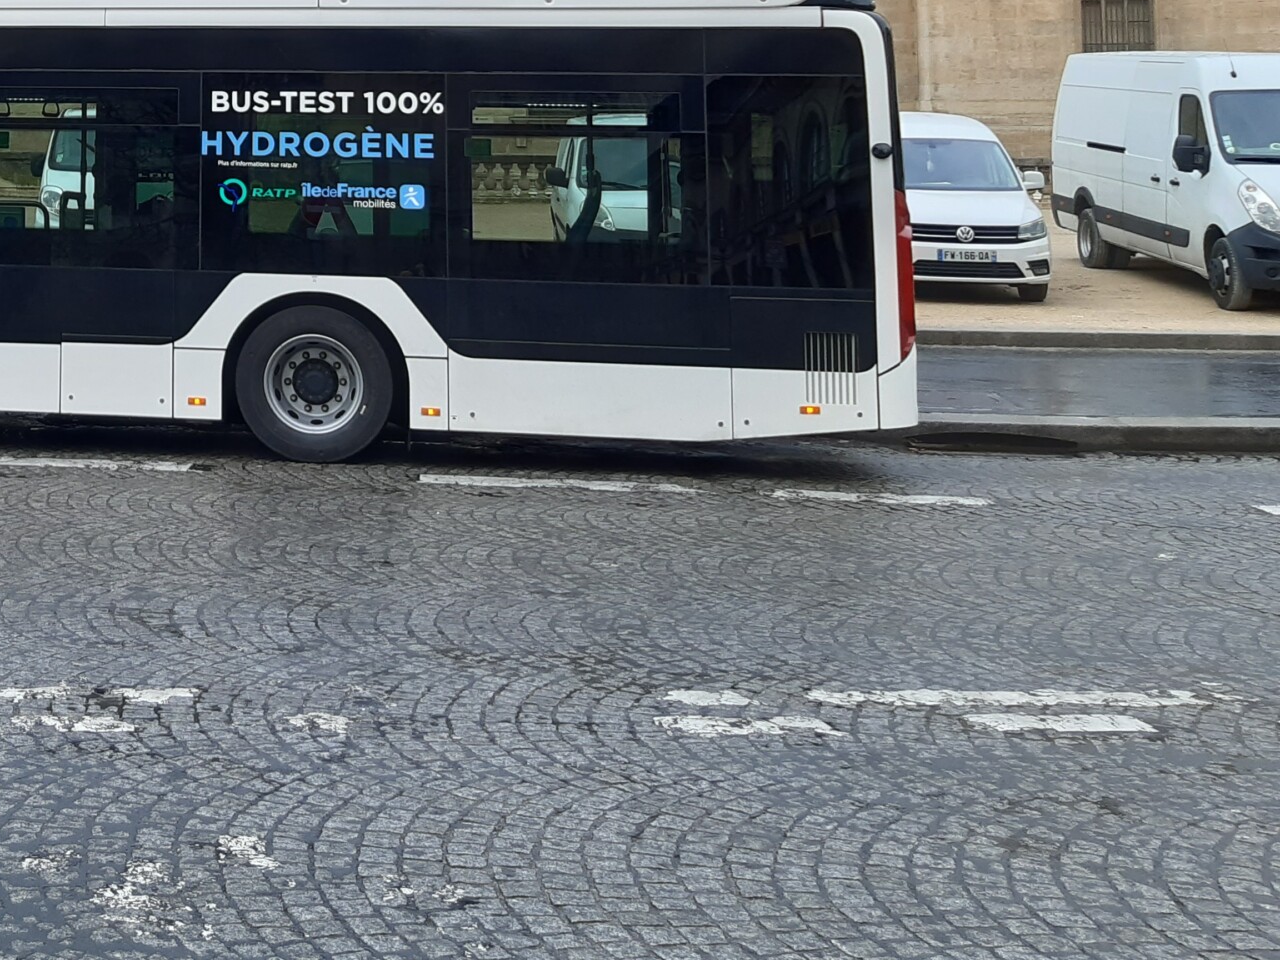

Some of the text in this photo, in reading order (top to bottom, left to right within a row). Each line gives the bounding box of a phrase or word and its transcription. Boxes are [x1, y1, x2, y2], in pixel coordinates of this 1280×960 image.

[211, 90, 444, 114] BUS-TEST 100%
[201, 125, 434, 159] HYDROGÈNE
[217, 159, 229, 167] Plus
[230, 160, 270, 168] d'informations
[252, 187, 296, 198] RATP
[353, 198, 396, 209] mobilités
